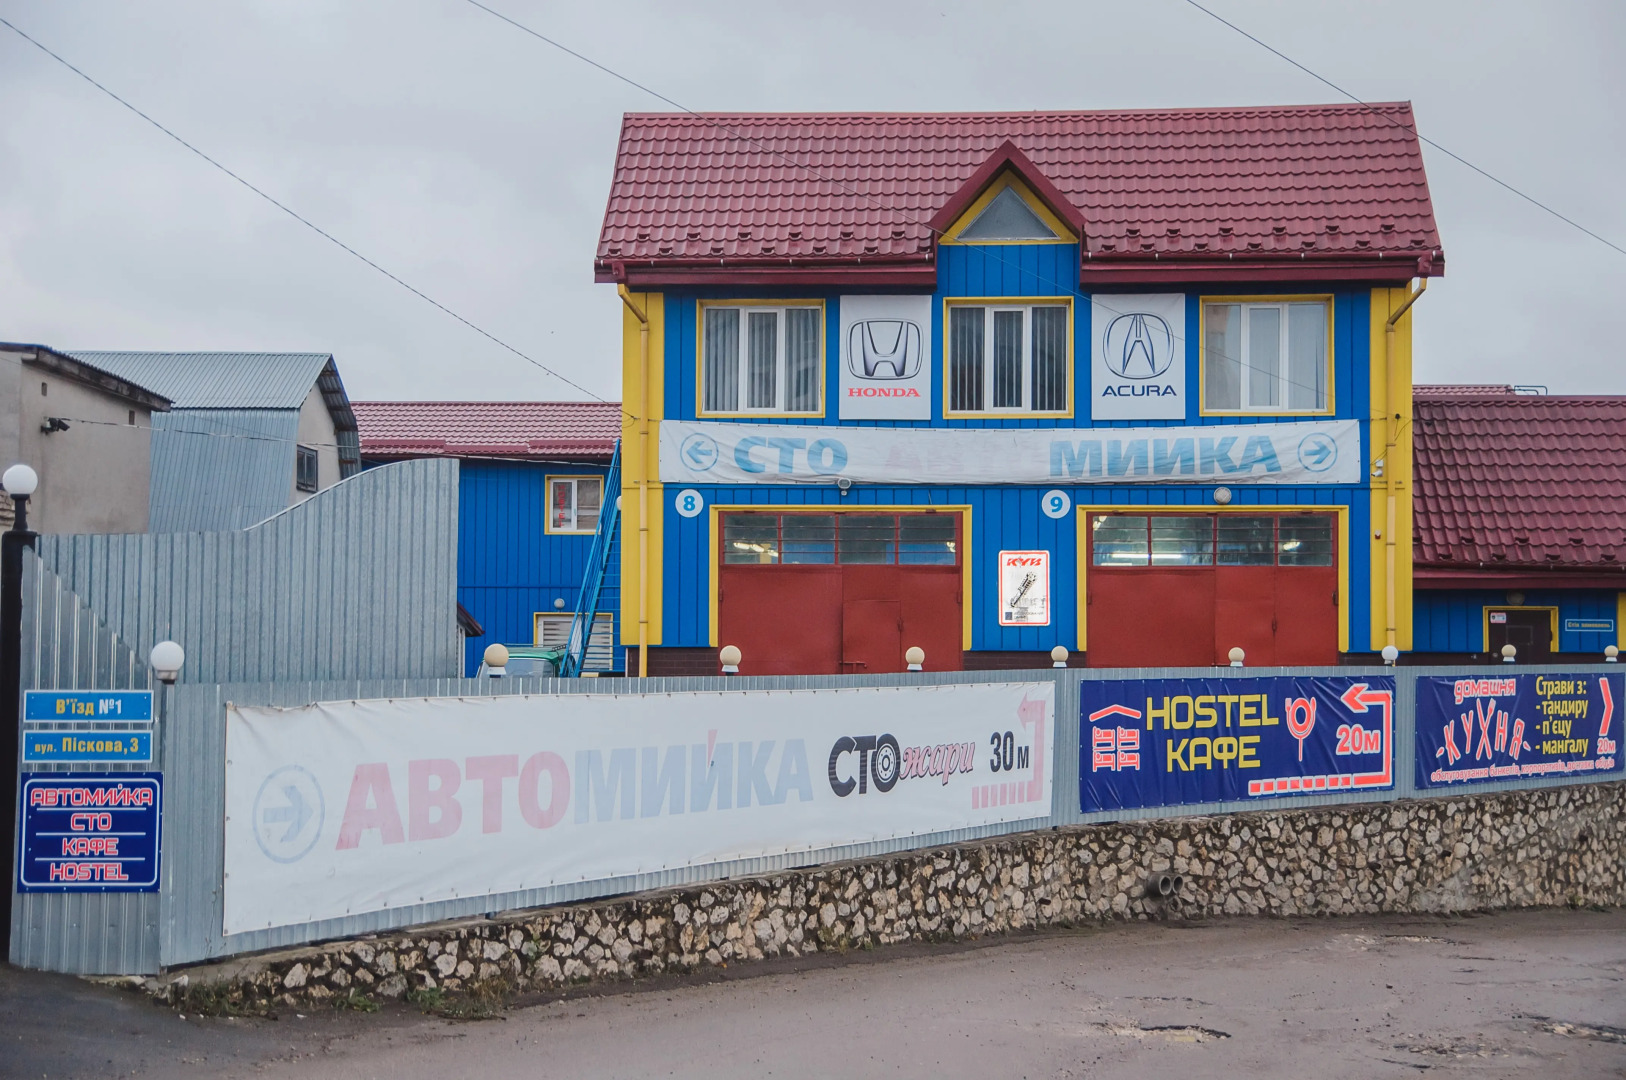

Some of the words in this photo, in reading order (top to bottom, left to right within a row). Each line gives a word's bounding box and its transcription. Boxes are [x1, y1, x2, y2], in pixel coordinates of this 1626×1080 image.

[848, 387, 921, 398] HONDA
[1102, 385, 1177, 397] ACURA
[733, 435, 848, 475] СТО
[683, 495, 696, 511] 8
[1050, 496, 1063, 513] 9
[1006, 557, 1042, 567] KYB
[1454, 678, 1517, 705] домашня
[1536, 676, 1574, 700] Страви
[1577, 681, 1587, 695] з:
[99, 699, 122, 715] №1
[1146, 693, 1280, 731] HOSTEL
[1443, 697, 1526, 766] КУХНЯ
[35, 743, 57, 754] вул.
[1166, 735, 1261, 772] КАФЕ
[31, 784, 153, 806] АВТОМИЙКА
[335, 729, 814, 851] АВТОМИЙКА
[70, 812, 112, 831] СТО
[61, 838, 119, 856] КАФЕ
[50, 863, 129, 881] HOSTEL
